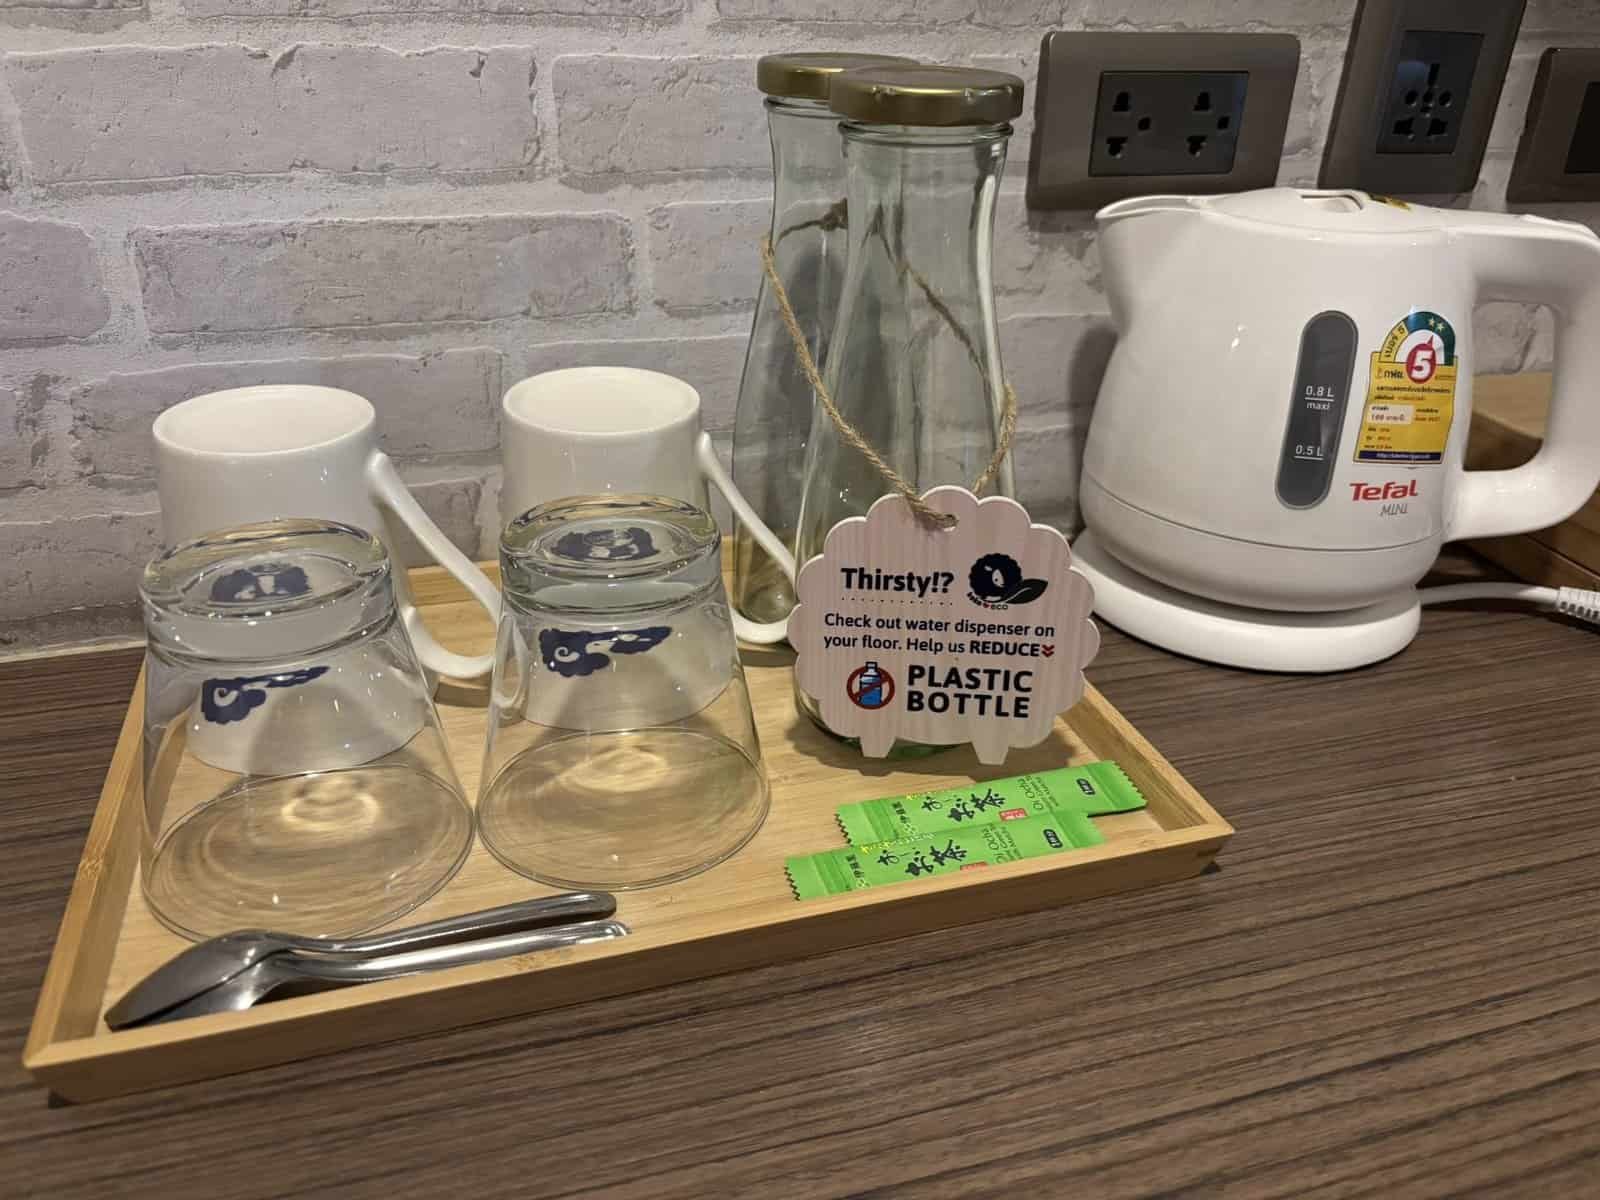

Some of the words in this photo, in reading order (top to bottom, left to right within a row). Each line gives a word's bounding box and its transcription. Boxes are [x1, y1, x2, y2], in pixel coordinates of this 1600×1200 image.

[1411, 349, 1433, 380] 5
[1305, 385, 1324, 397] 0.8
[1327, 387, 1335, 398] L
[1306, 402, 1330, 410] maxi
[1295, 444, 1315, 456] 0.5
[1317, 446, 1324, 457] L
[1349, 480, 1418, 501] Tefal
[1380, 503, 1408, 516] MINI
[841, 567, 954, 598] Thirsty!?
[824, 613, 871, 628] Check
[875, 615, 901, 629] out
[905, 617, 950, 632] water
[954, 618, 1030, 641] dispenser
[1034, 625, 1055, 637] on
[823, 635, 858, 649] your
[861, 634, 902, 650] floor.
[906, 637, 943, 655] Help
[948, 642, 965, 653] us
[969, 640, 1040, 657] REDUCE
[907, 665, 1032, 692] PLASTIC
[906, 690, 1030, 718] BOTTLE
